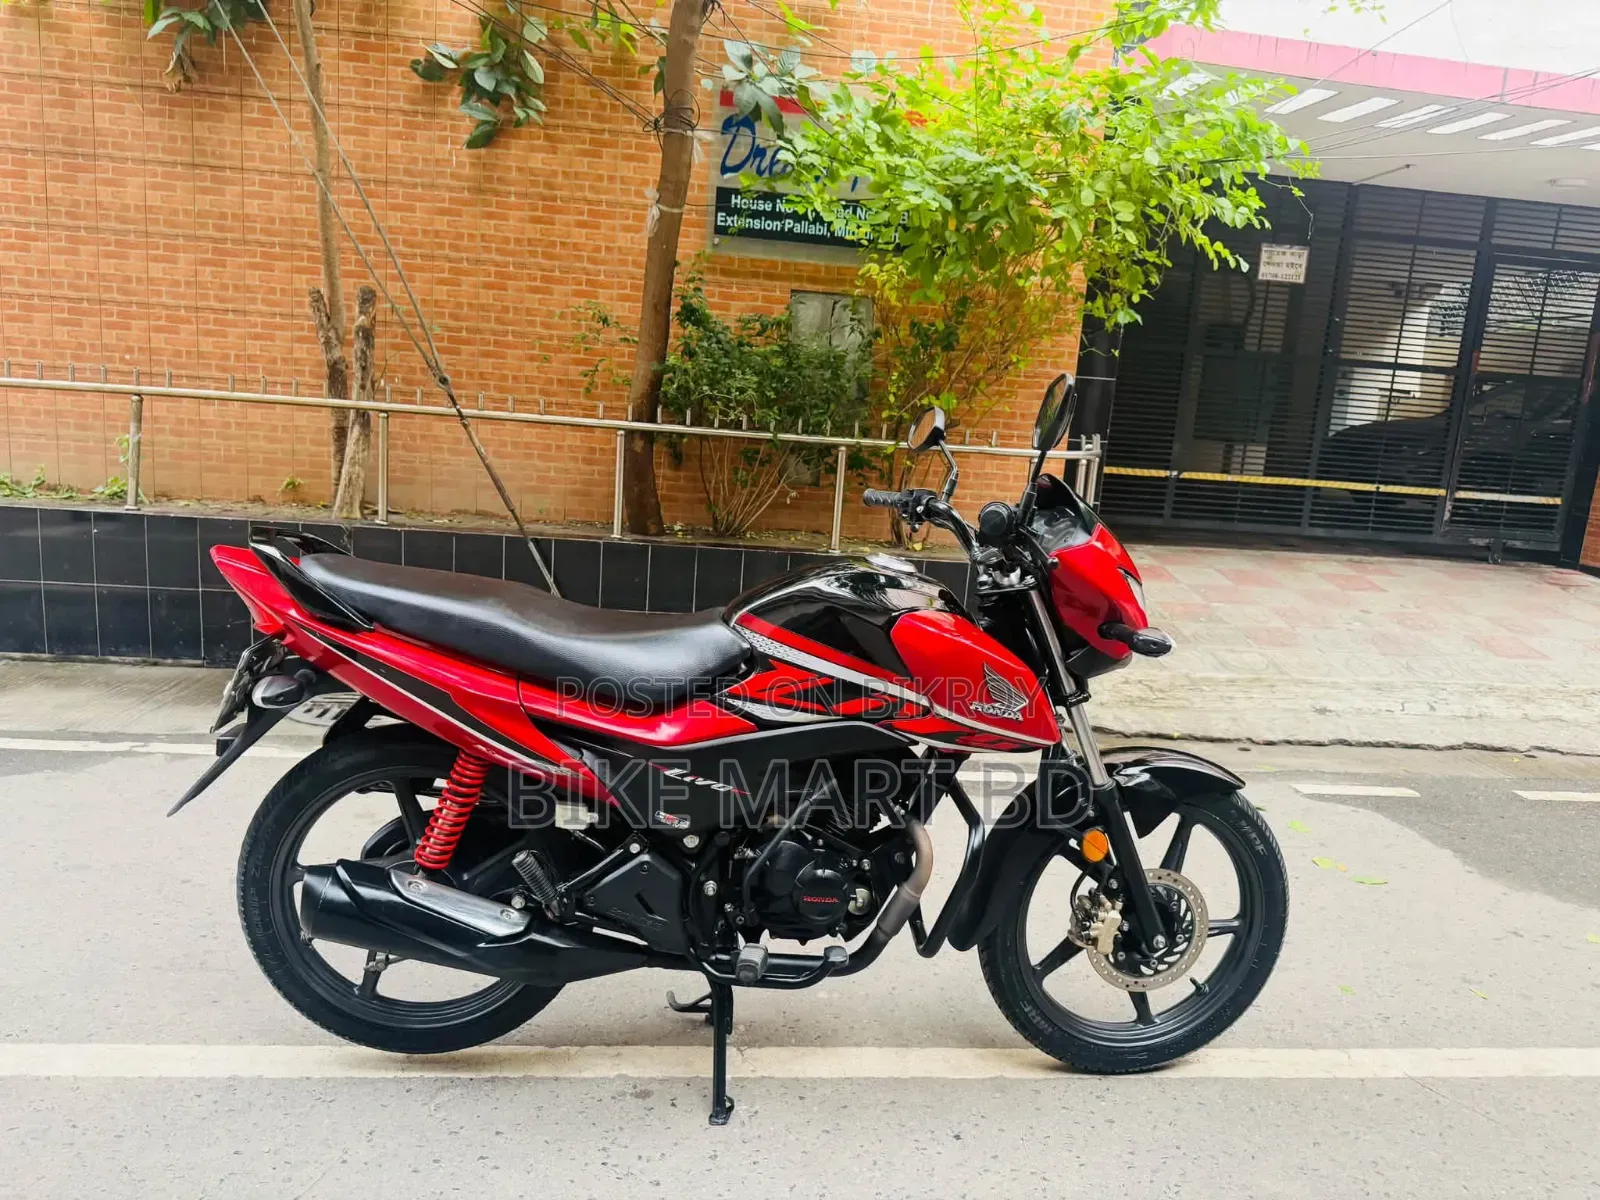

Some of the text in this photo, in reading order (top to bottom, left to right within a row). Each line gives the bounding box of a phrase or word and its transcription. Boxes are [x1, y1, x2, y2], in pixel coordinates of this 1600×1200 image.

[731, 194, 773, 212] House
[784, 219, 830, 238] Pallabi,
[969, 701, 1024, 722] HONDA
[803, 895, 839, 904] HONDA
